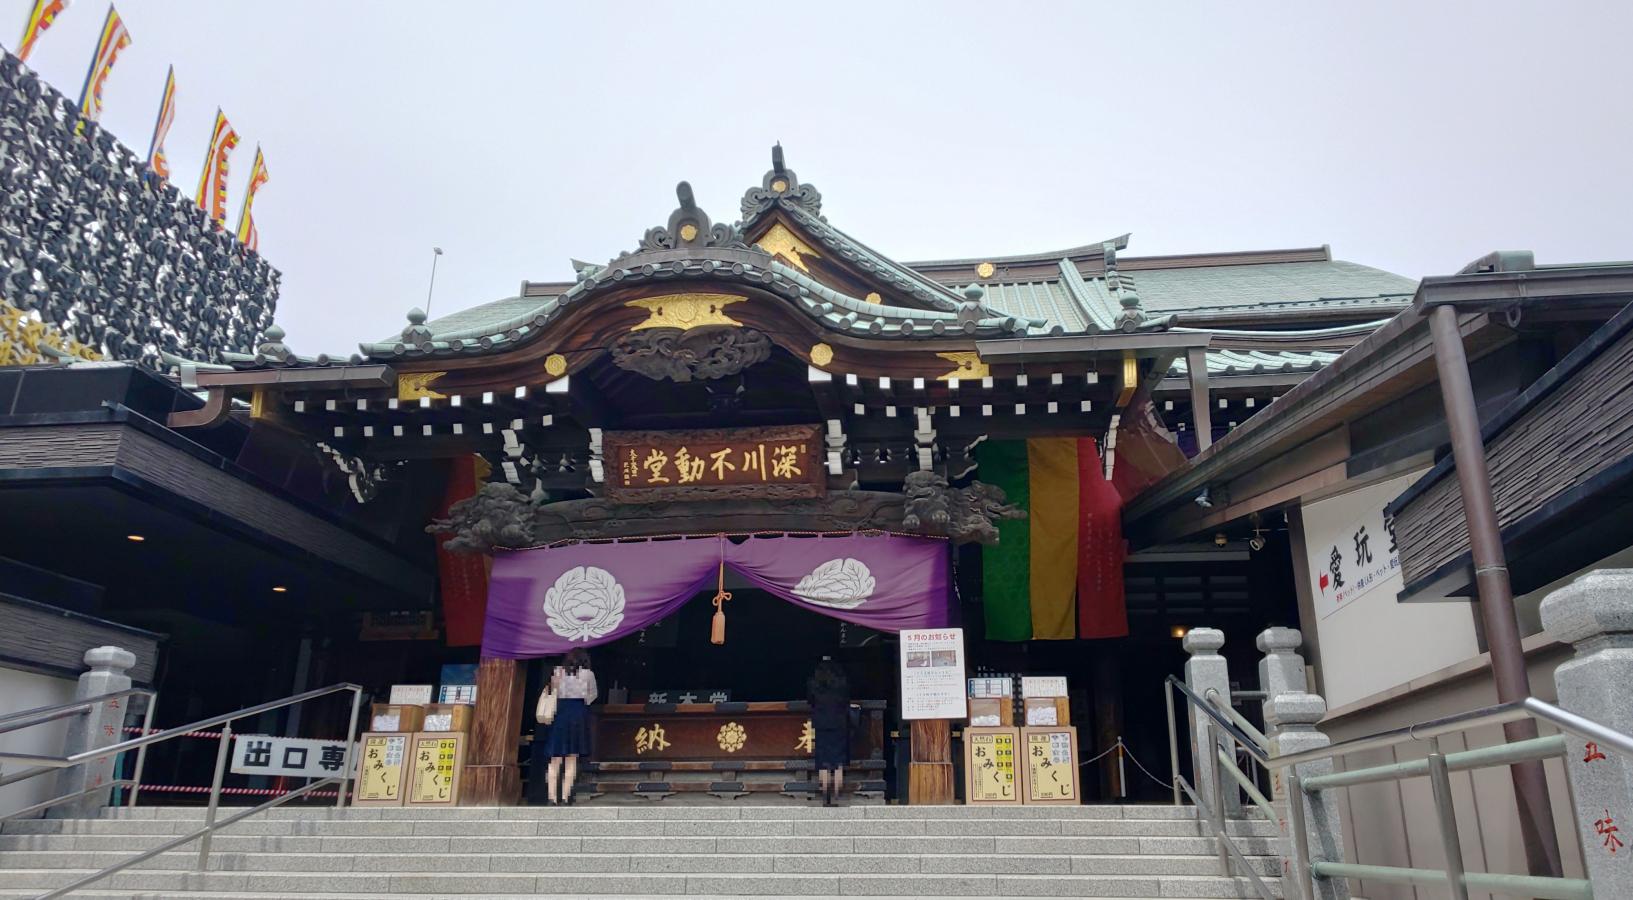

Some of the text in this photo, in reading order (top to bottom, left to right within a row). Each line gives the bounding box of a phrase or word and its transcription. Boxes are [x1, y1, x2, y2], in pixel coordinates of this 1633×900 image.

[243, 740, 357, 772] 出口専
[367, 748, 396, 796] おみくじ
[419, 750, 447, 798] おみくじ
[975, 745, 1011, 796] おみくじ
[1032, 745, 1070, 796] おみくじ
